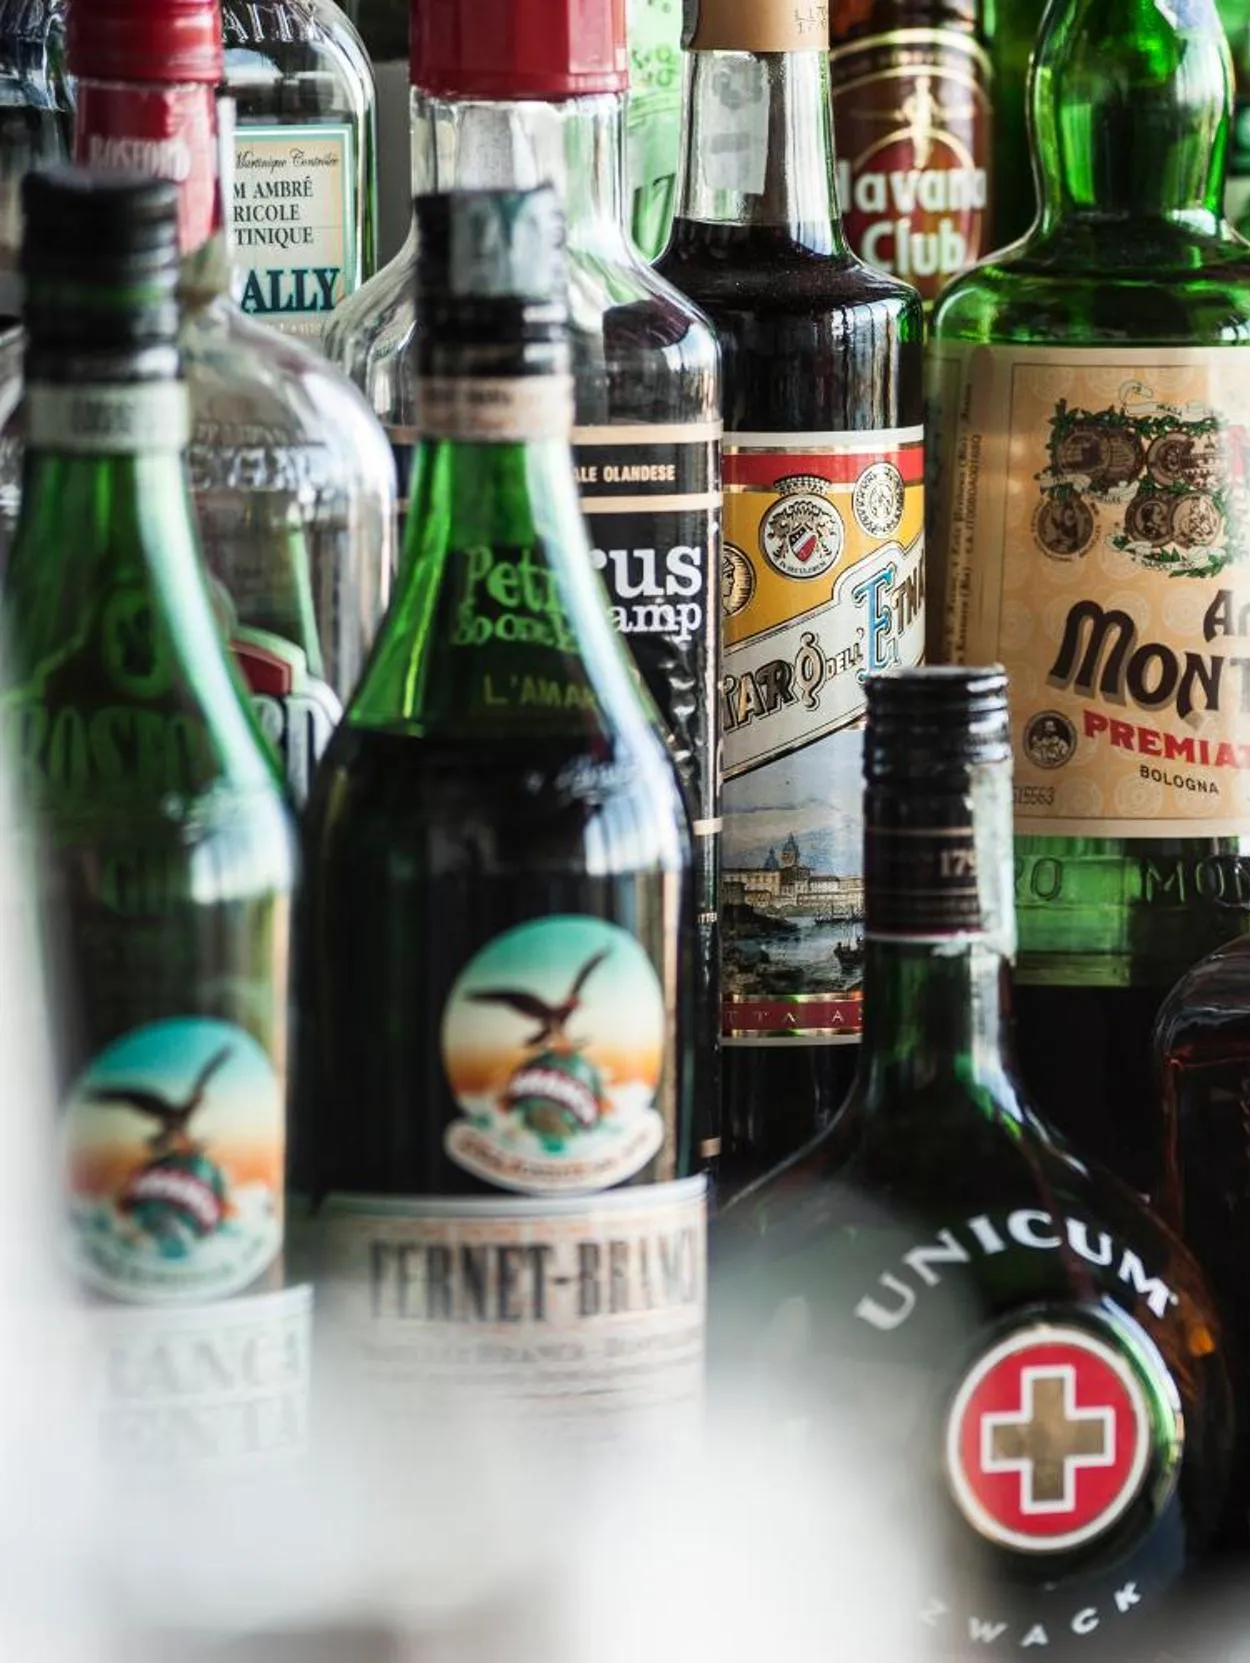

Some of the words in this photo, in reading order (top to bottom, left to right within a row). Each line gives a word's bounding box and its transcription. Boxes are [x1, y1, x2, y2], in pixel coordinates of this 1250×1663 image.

[254, 176, 314, 199] AMBRÉ
[233, 204, 301, 222] RICOLE
[235, 226, 315, 249] TINIQUE
[861, 216, 968, 275] Club
[240, 267, 341, 313] ALLY
[603, 464, 676, 483] OLANDESE
[611, 601, 702, 642] amp
[1139, 764, 1219, 795] BOLOGNA
[854, 1208, 1173, 1331] UNICUM
